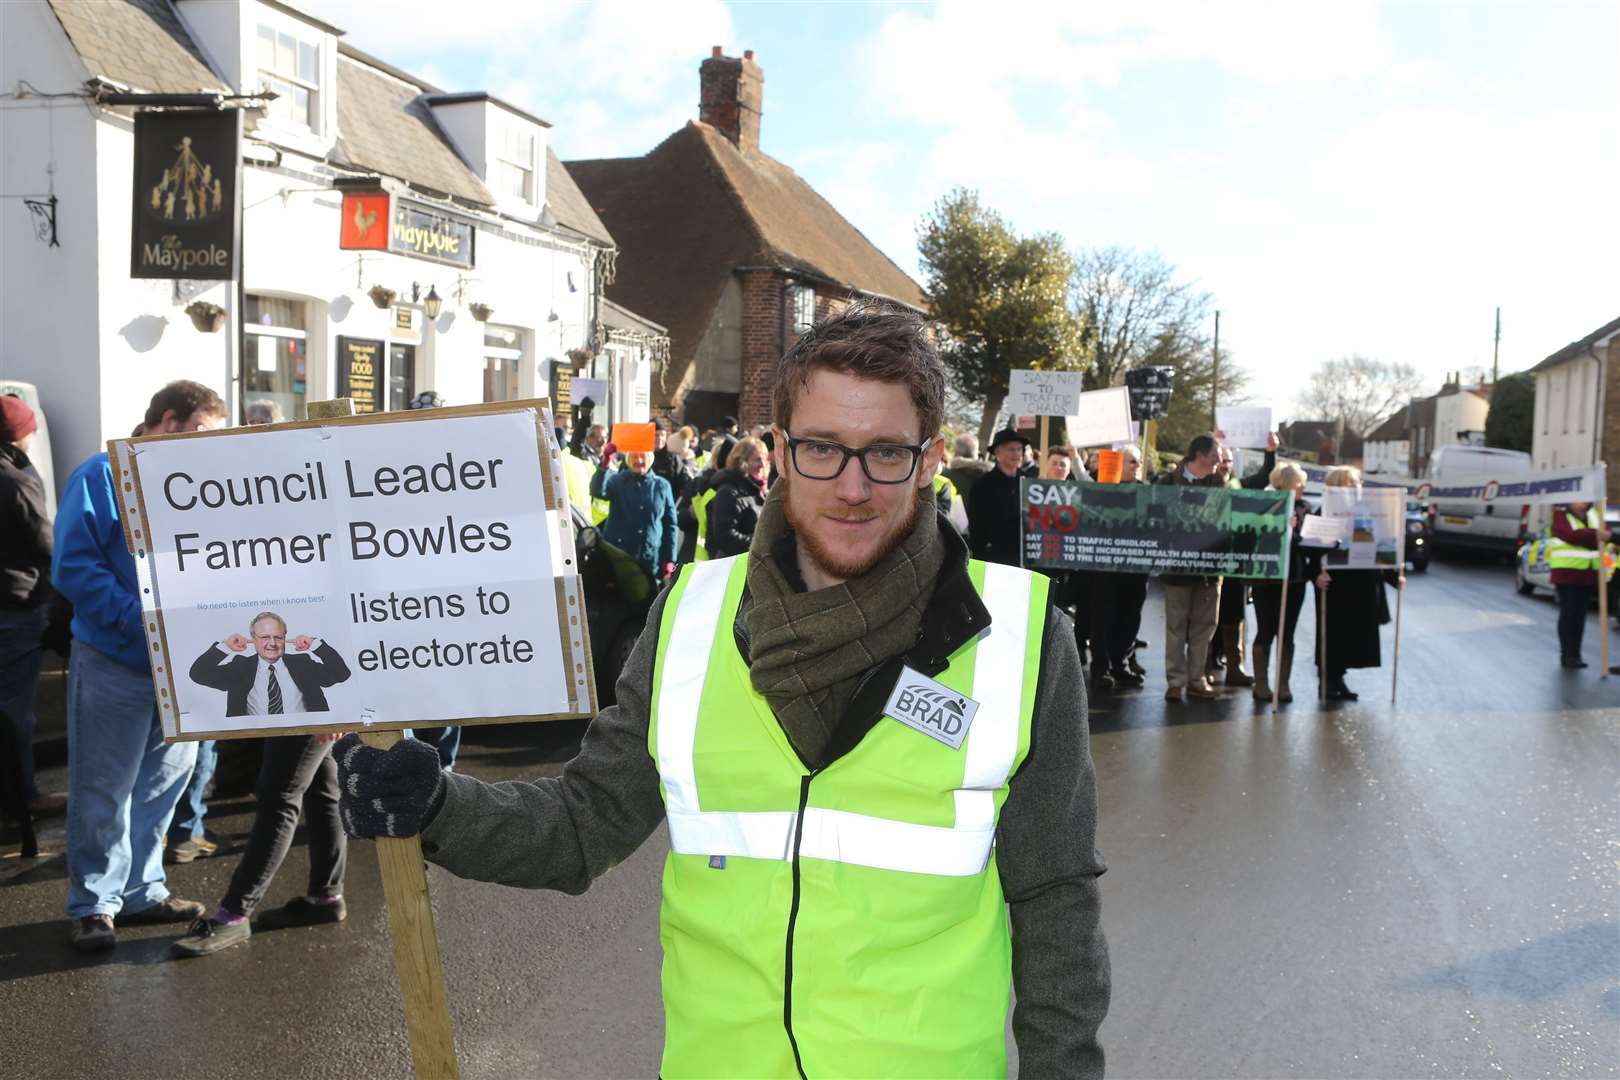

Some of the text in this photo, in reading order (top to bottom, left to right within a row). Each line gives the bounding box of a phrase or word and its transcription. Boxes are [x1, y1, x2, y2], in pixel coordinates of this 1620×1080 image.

[142, 243, 228, 271] Maypole
[351, 362, 373, 375] FOOD
[1024, 372, 1077, 385] SAY NO
[1021, 392, 1072, 405] TRAFFIC
[1037, 384, 1054, 393] TO
[164, 452, 504, 511] Council Leader
[1028, 483, 1079, 506] SAY
[1028, 504, 1079, 533] NO
[175, 515, 512, 572] Farmer Bowles
[1025, 533, 1042, 542] SAY
[1064, 536, 1076, 544] TO
[1077, 536, 1113, 546] TRAFFIC
[1114, 538, 1159, 548] GRIDLOCK
[1026, 542, 1042, 550] SAY
[1077, 545, 1095, 554] THE
[1096, 547, 1145, 556] INCREASED
[1145, 549, 1180, 558] HEALTH
[1183, 551, 1200, 559] AND
[1201, 552, 1250, 561] EDUCATION
[1251, 553, 1280, 561] CRISIS
[1026, 551, 1042, 560] SAY
[1064, 553, 1075, 561] TO
[1077, 553, 1093, 562] THE
[1095, 555, 1112, 563] USE
[1113, 556, 1124, 564] OF
[1127, 557, 1152, 566] PRIME
[1154, 558, 1215, 569] AGRICULTURAL
[1217, 561, 1240, 569] LAND
[209, 601, 228, 610] need
[238, 600, 259, 608] listen
[259, 599, 283, 608] when
[286, 596, 307, 605] know
[351, 585, 510, 624] listens to
[357, 634, 534, 672] electorate
[895, 689, 963, 736] BRAD
